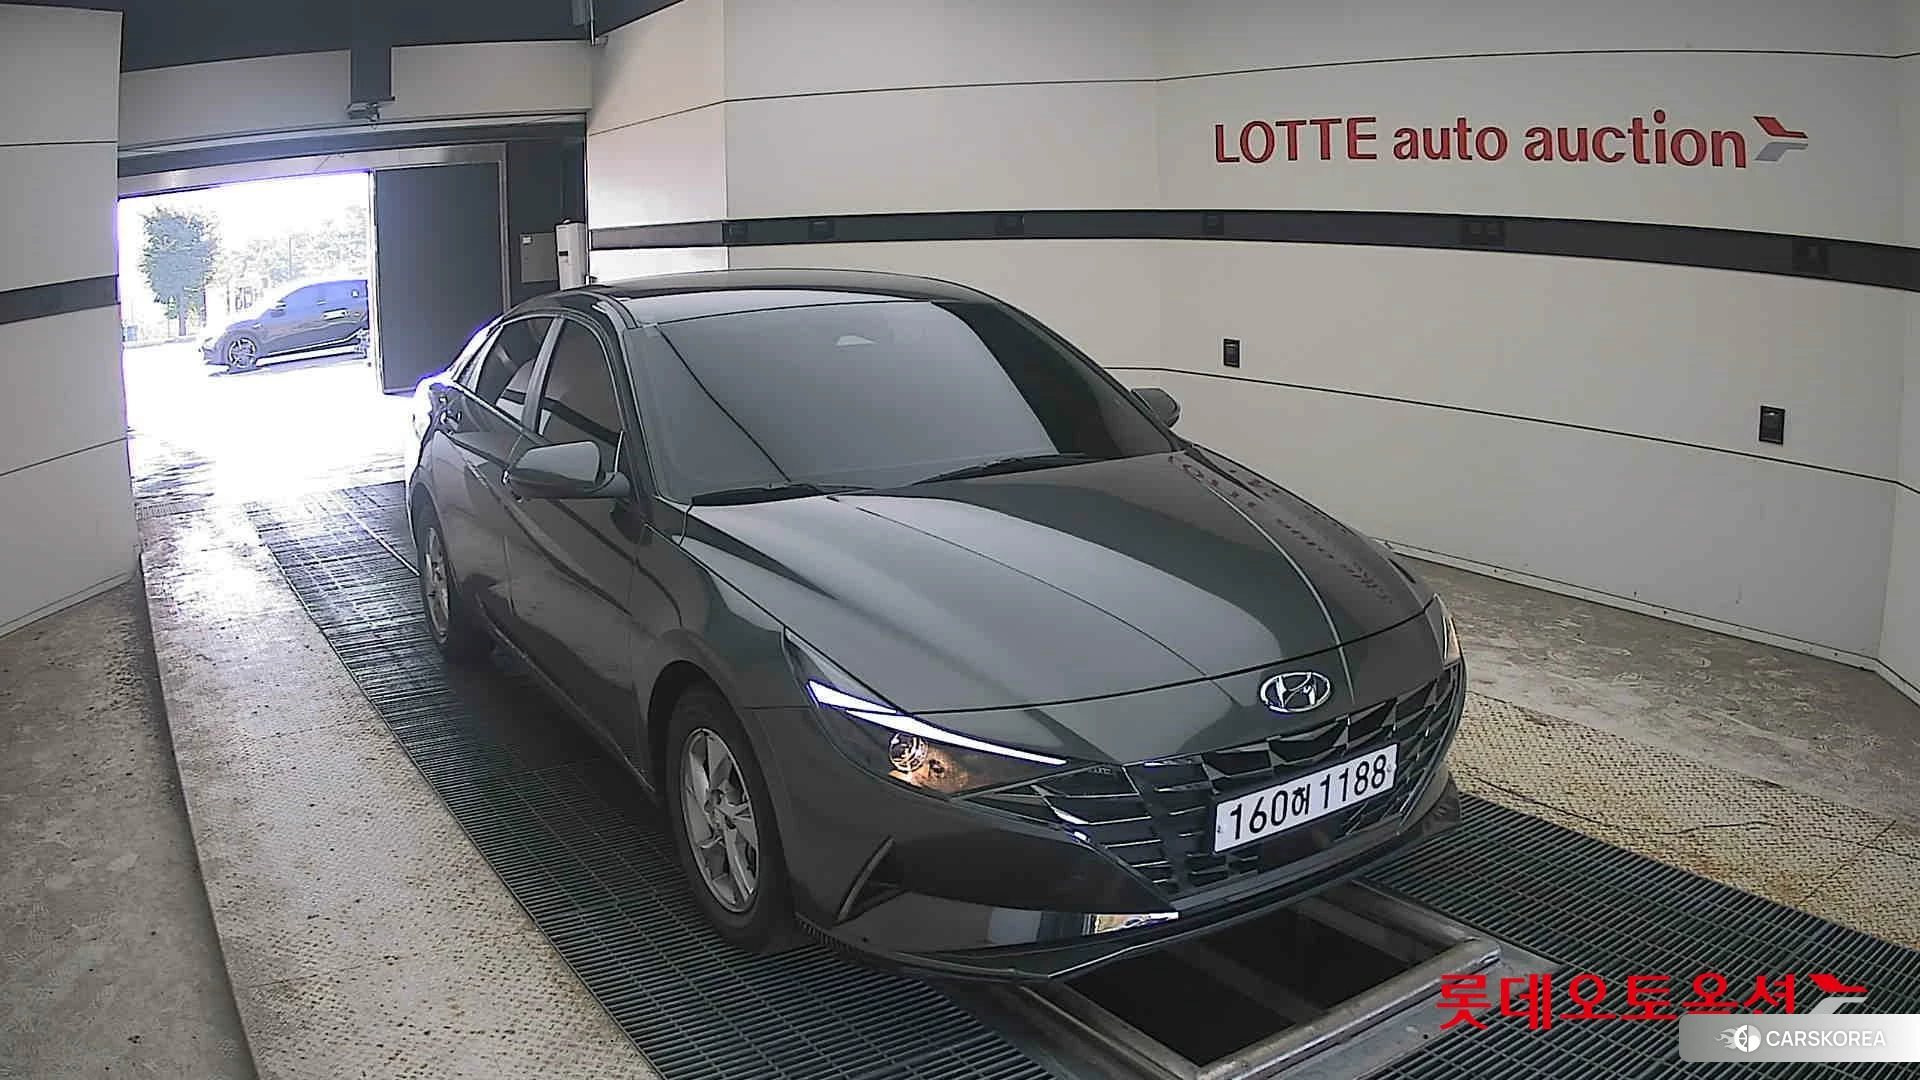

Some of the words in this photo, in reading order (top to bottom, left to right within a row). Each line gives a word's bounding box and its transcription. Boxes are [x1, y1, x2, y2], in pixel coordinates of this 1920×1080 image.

[1215, 116, 1377, 164] LOTTE
[1392, 117, 1509, 161] auto
[1523, 110, 1748, 168] auction
[1319, 754, 1387, 809] 1188
